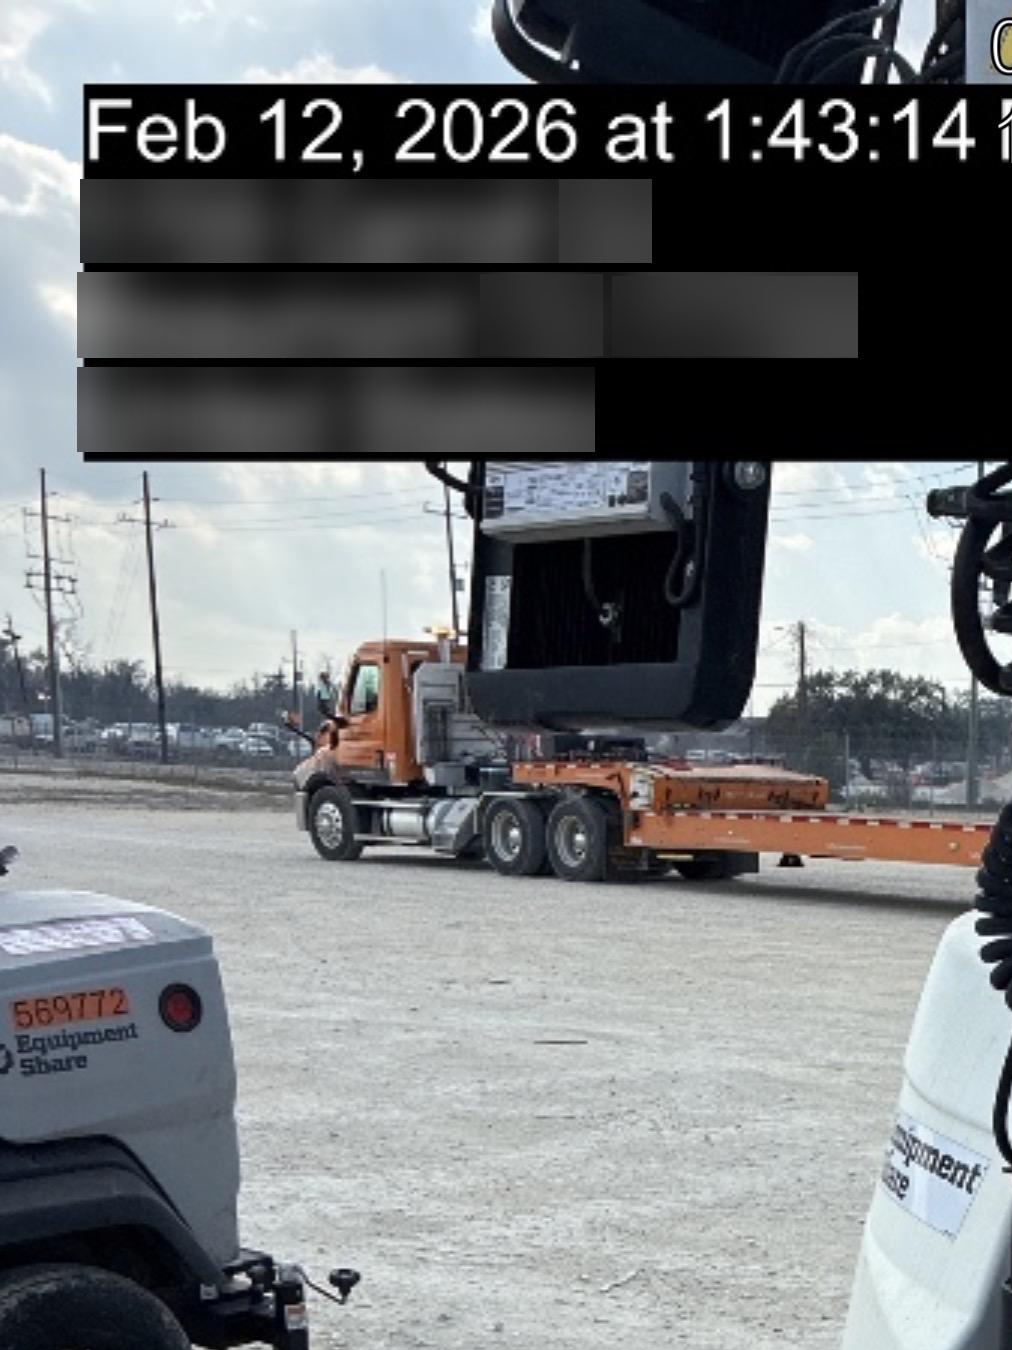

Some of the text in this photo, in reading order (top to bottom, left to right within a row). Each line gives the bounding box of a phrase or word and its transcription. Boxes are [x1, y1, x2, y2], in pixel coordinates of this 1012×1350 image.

[13, 988, 129, 1029] 569772
[15, 1023, 139, 1055] Equipment
[20, 1055, 88, 1077] Share
